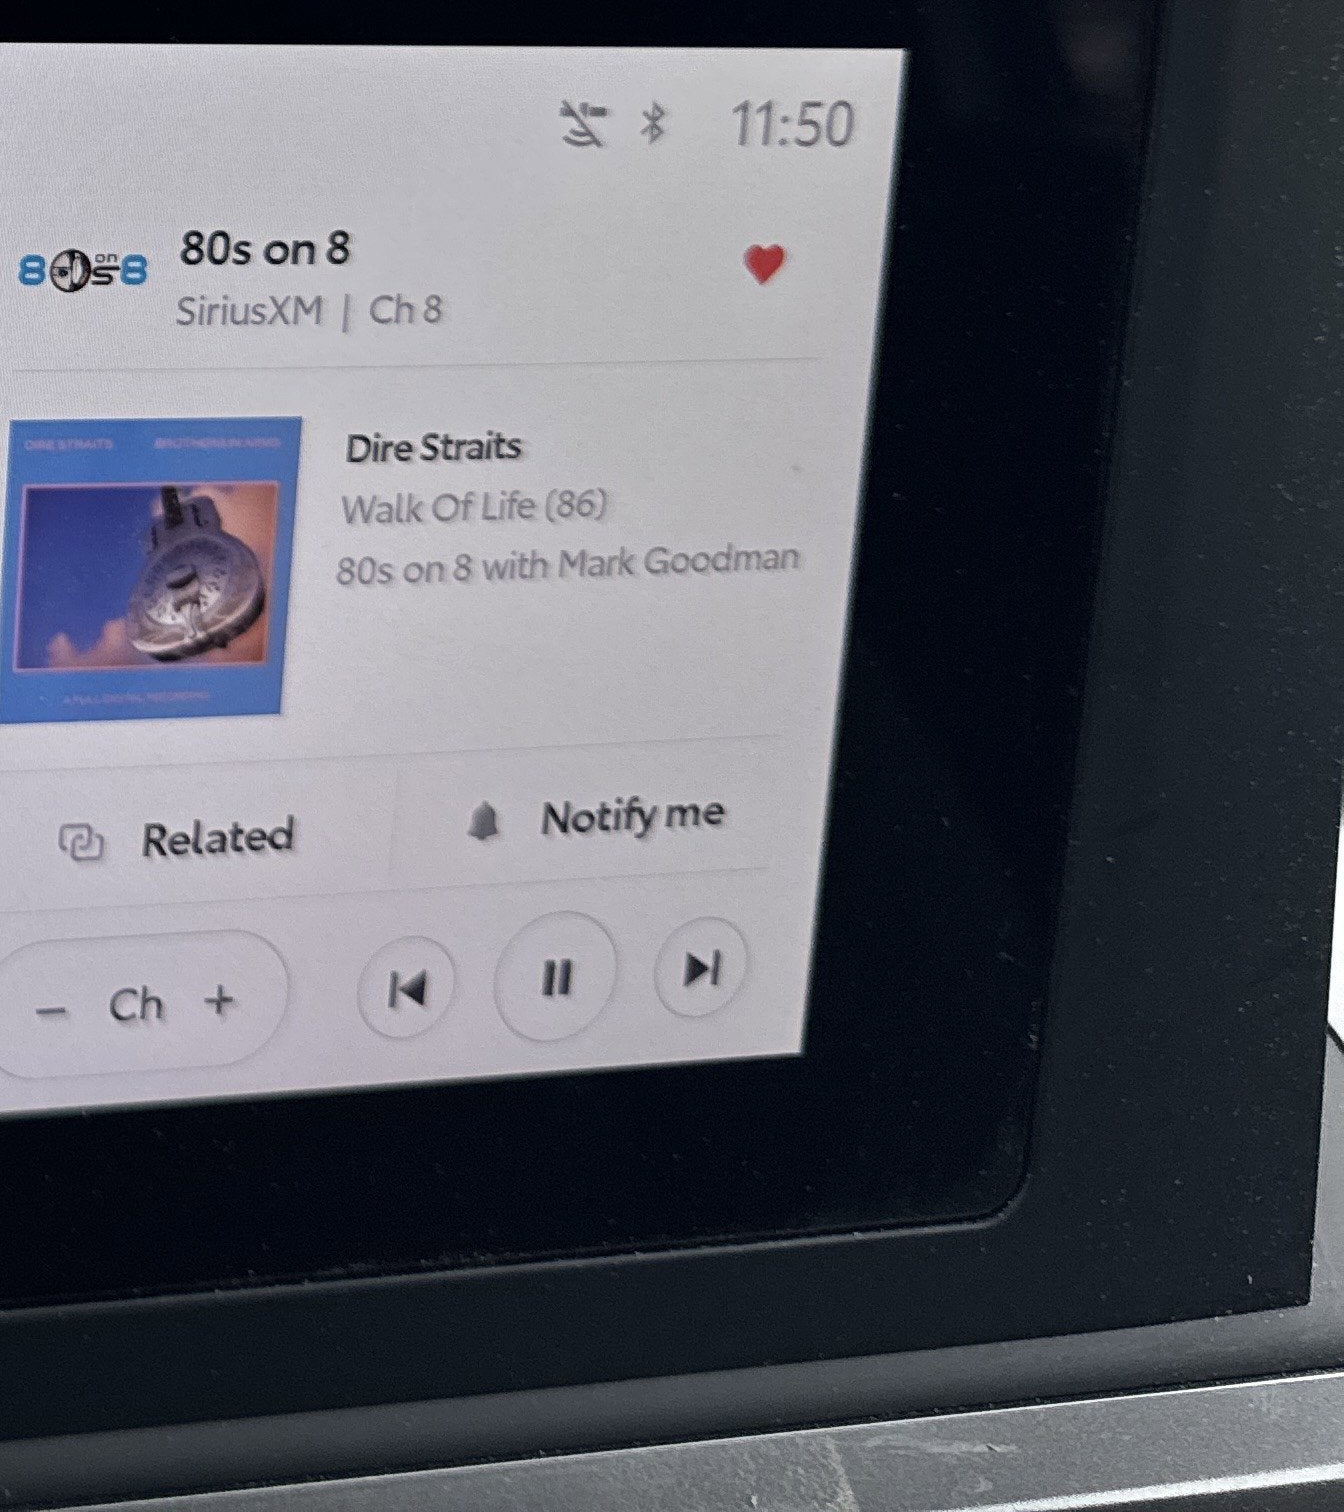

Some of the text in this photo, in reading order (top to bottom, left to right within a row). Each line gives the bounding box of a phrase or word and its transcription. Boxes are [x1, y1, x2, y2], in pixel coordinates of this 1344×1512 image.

[733, 99, 855, 149] 11:50
[180, 229, 351, 266] 80s on 8
[176, 295, 324, 327] SiriusXM
[369, 294, 416, 326] Ch
[423, 294, 444, 325] 8
[346, 432, 523, 465] Dire Straits
[341, 487, 609, 525] Walk Of Life (86)
[335, 543, 802, 588] 80s on 8 with Mark Goodman
[542, 796, 727, 839] Notify me
[143, 816, 295, 858] Related
[109, 986, 165, 1024] Ch
